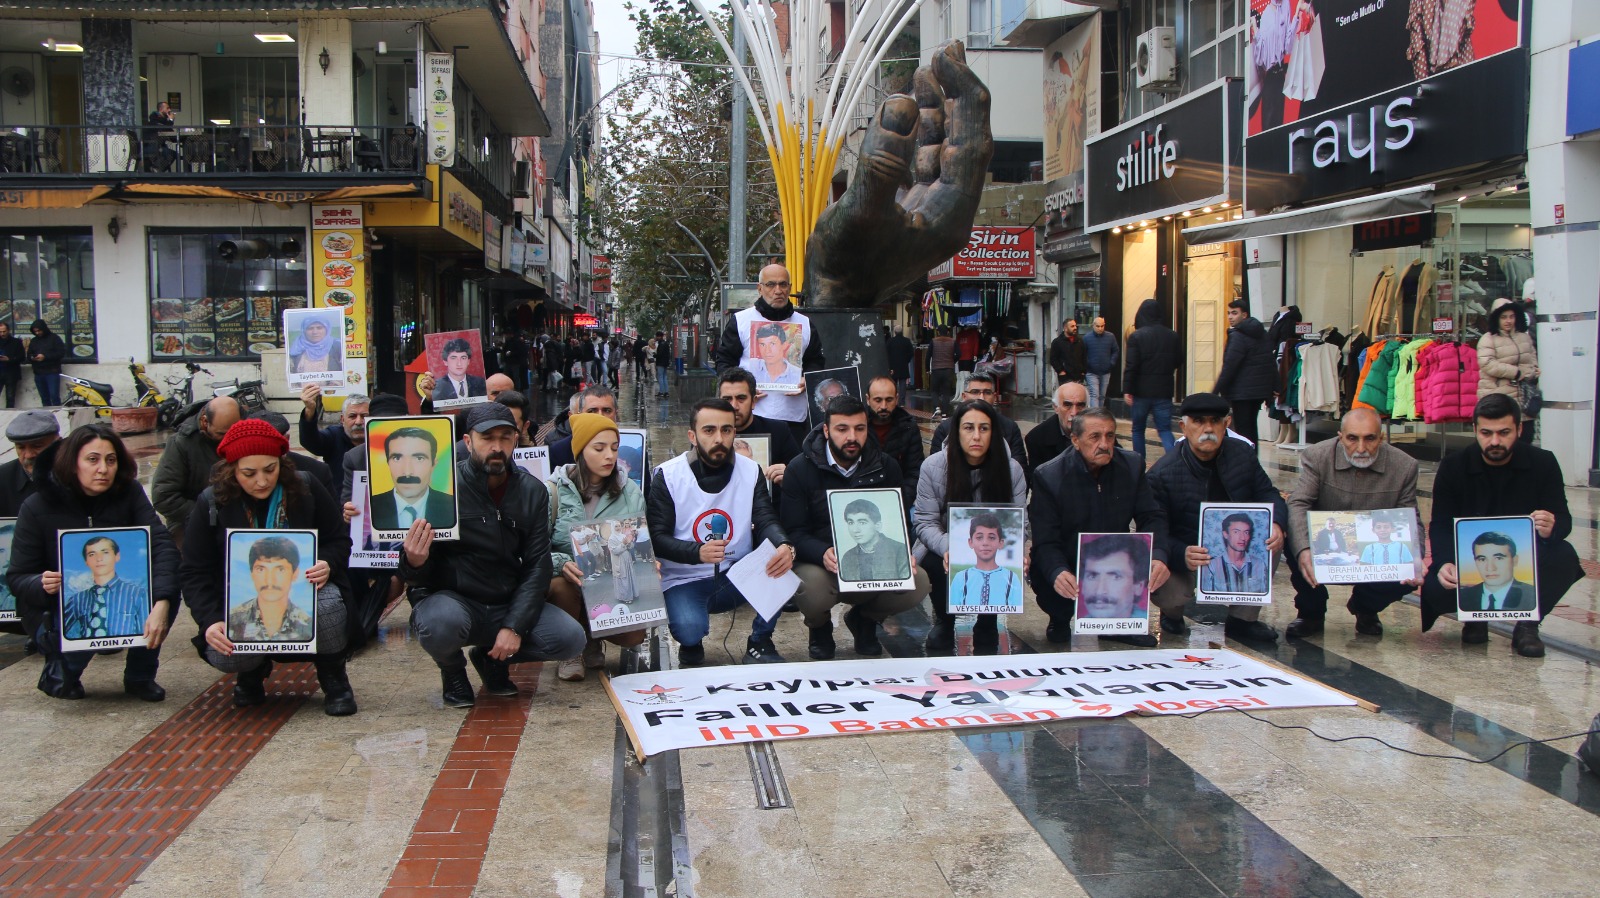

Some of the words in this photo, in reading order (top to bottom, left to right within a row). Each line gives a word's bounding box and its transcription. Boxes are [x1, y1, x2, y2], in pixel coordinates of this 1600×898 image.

[1288, 96, 1414, 175] rays
[1116, 123, 1176, 192] stilife
[321, 208, 353, 217] ŞEHİR
[314, 218, 361, 226] SOFRASI
[968, 230, 1020, 249] Şirin
[957, 247, 1030, 259] Collection
[524, 449, 546, 460] ÇELİK
[1327, 565, 1361, 573] İBRAHİM
[1328, 574, 1363, 582] VEYSEL
[856, 582, 881, 590] ÇETİN
[955, 605, 983, 613] VEYSEL
[984, 605, 1017, 613] ATILGAN
[595, 615, 634, 628] MERYEM
[635, 609, 663, 621] BULUT
[1502, 611, 1532, 620] SAÇAN
[1079, 622, 1114, 630] Hüseyin
[1116, 621, 1143, 629] SEVİM
[89, 639, 120, 648] AYDIN
[121, 638, 135, 646] AY
[231, 643, 279, 651] ABDULLAH
[281, 643, 310, 651] BULUT
[643, 700, 877, 727] Failler
[830, 709, 1061, 734] Batman
